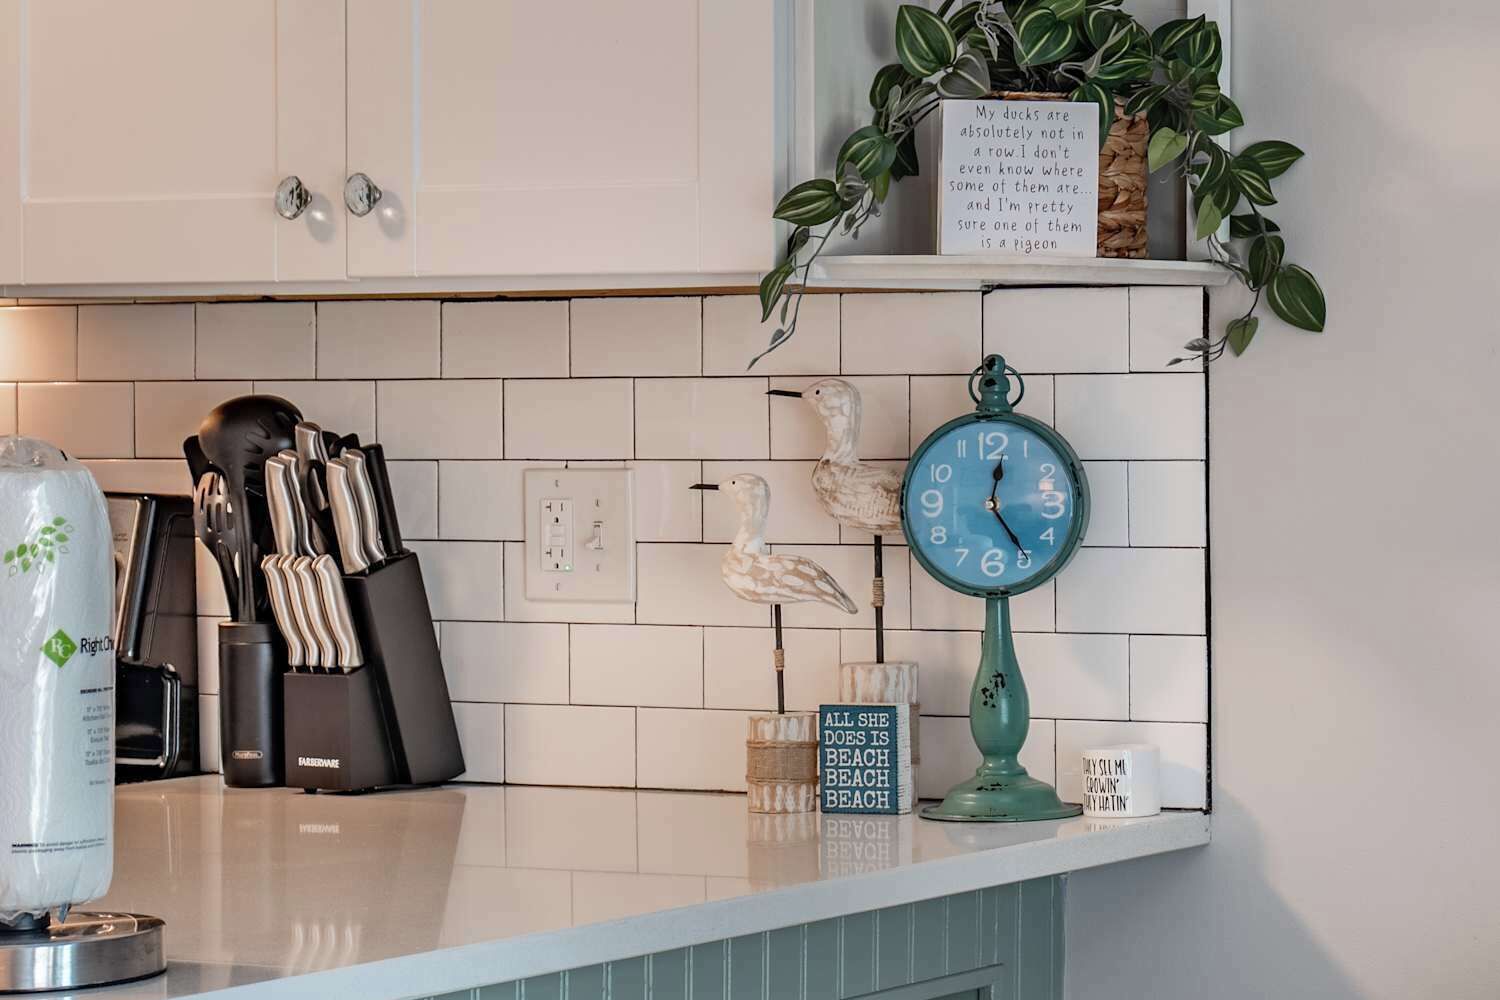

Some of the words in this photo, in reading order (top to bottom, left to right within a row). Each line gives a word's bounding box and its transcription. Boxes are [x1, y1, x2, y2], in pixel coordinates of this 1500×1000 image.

[976, 105, 995, 121] My
[1003, 106, 1039, 121] ducks
[1047, 111, 1069, 122] are
[960, 126, 1033, 141] absolutely
[1041, 128, 1065, 139] not
[1072, 126, 1084, 139] in
[973, 148, 981, 157] a
[1021, 144, 1026, 159] I
[1033, 144, 1070, 159] don't
[959, 164, 991, 175] even
[999, 162, 1034, 176] know
[1042, 164, 1083, 177] where
[949, 180, 984, 192] some
[992, 180, 1007, 192] of
[1015, 180, 1049, 193] them
[967, 198, 990, 212] and
[998, 197, 1020, 212] I'm
[1028, 198, 1073, 213] pretty
[958, 219, 986, 231] sure
[994, 222, 1017, 231] one
[1025, 219, 1039, 233] of
[1048, 219, 1082, 233] them
[981, 237, 991, 248] is
[999, 239, 1006, 248] a
[1014, 236, 1057, 253] pigeon
[957, 439, 967, 458] 11
[978, 432, 1009, 461] 12
[1023, 440, 1028, 458] 1
[930, 464, 953, 483] 10
[1039, 463, 1056, 482] 2
[920, 489, 944, 518] 9
[1040, 490, 1066, 519] 3
[930, 526, 947, 544] 8
[1039, 527, 1055, 546] 4
[954, 549, 969, 567] 7
[980, 549, 1005, 577] 6
[1016, 549, 1032, 569] 5
[824, 712, 854, 727] ALL
[858, 713, 890, 728] SHE
[824, 730, 866, 745] DOES
[870, 731, 889, 745] IS
[298, 756, 340, 768] FARBERWARE
[825, 748, 890, 767] BEACH
[825, 768, 890, 787] BEACH
[825, 790, 890, 809] BEACH
